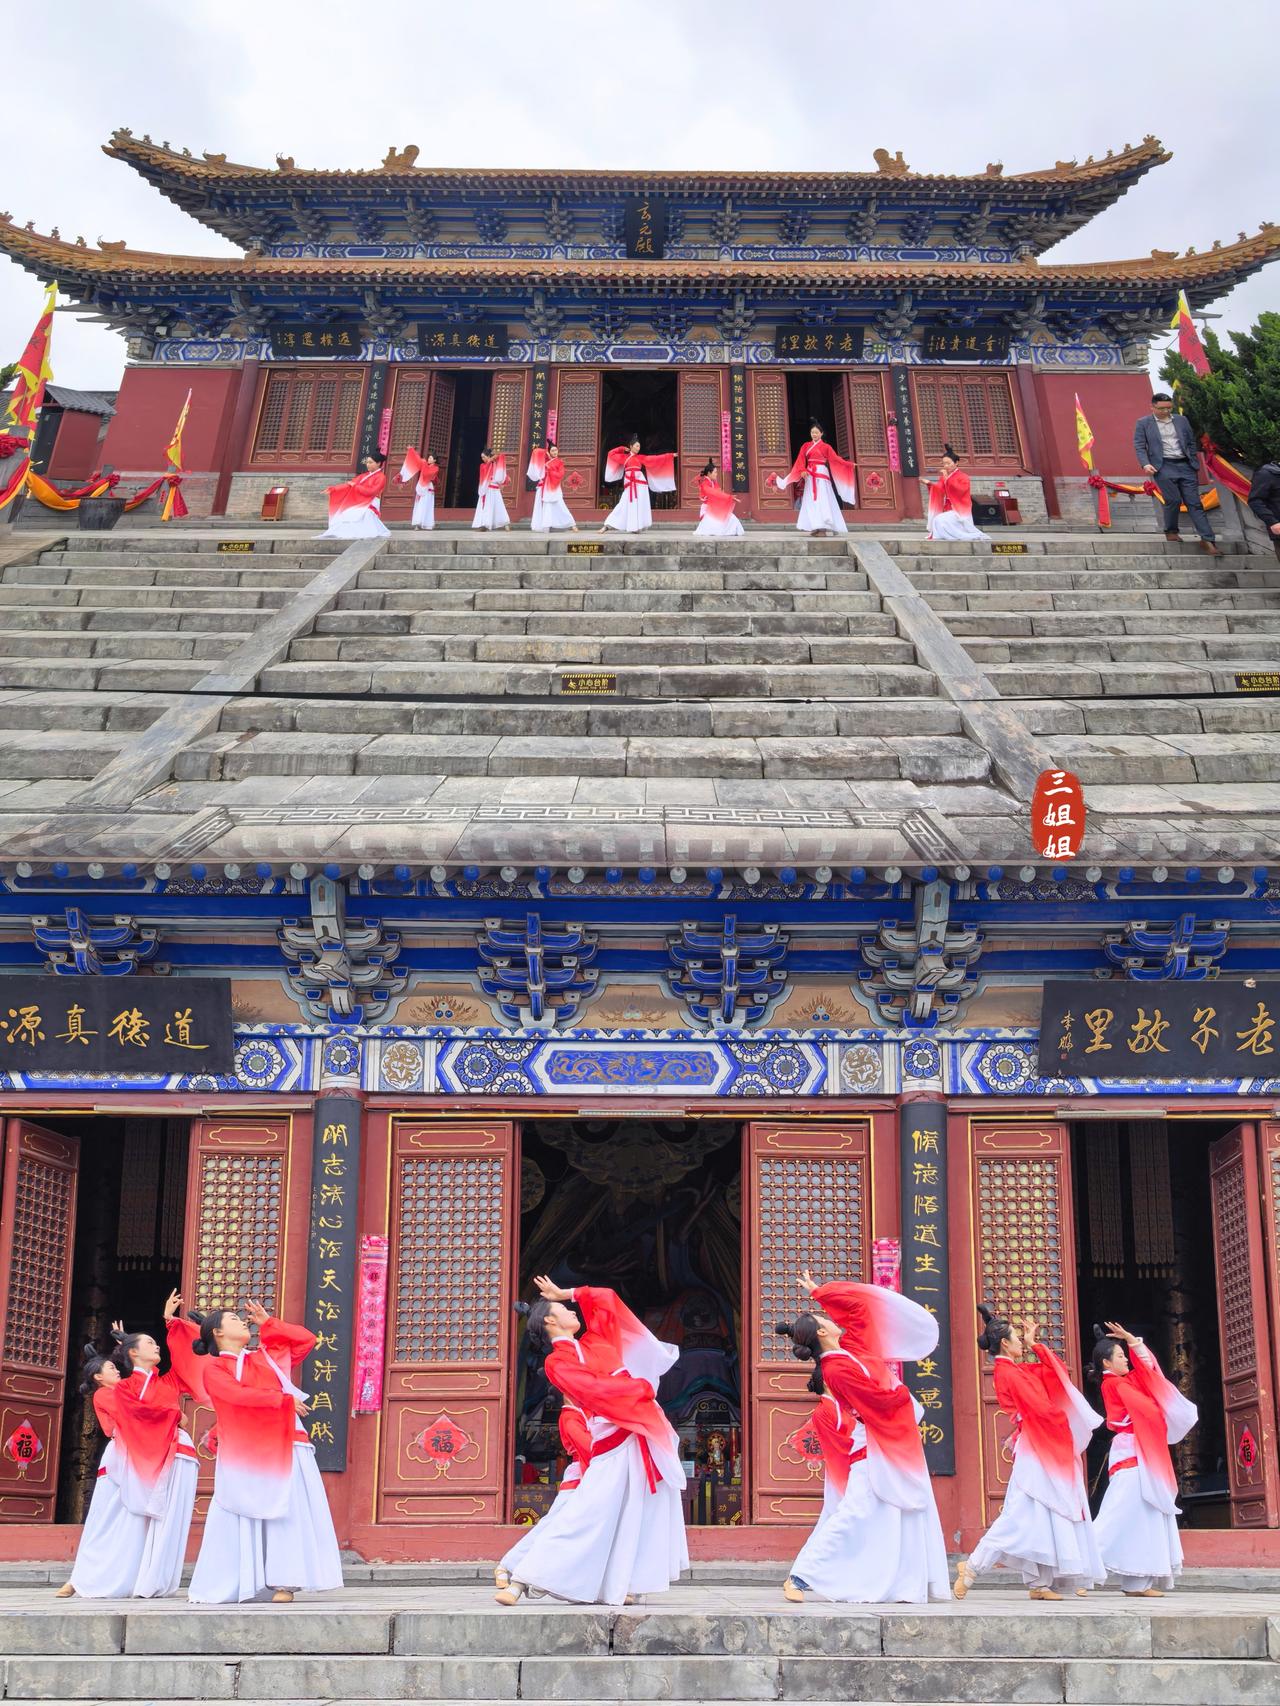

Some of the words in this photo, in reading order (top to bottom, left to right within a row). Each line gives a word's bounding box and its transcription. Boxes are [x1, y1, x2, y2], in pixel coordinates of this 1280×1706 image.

[635, 201, 654, 253] 玄元殿
[789, 333, 853, 352] 老子故里
[1083, 1002, 1276, 1056] 老子故里
[16, 1433, 33, 1458] 福
[431, 1430, 455, 1454] 福
